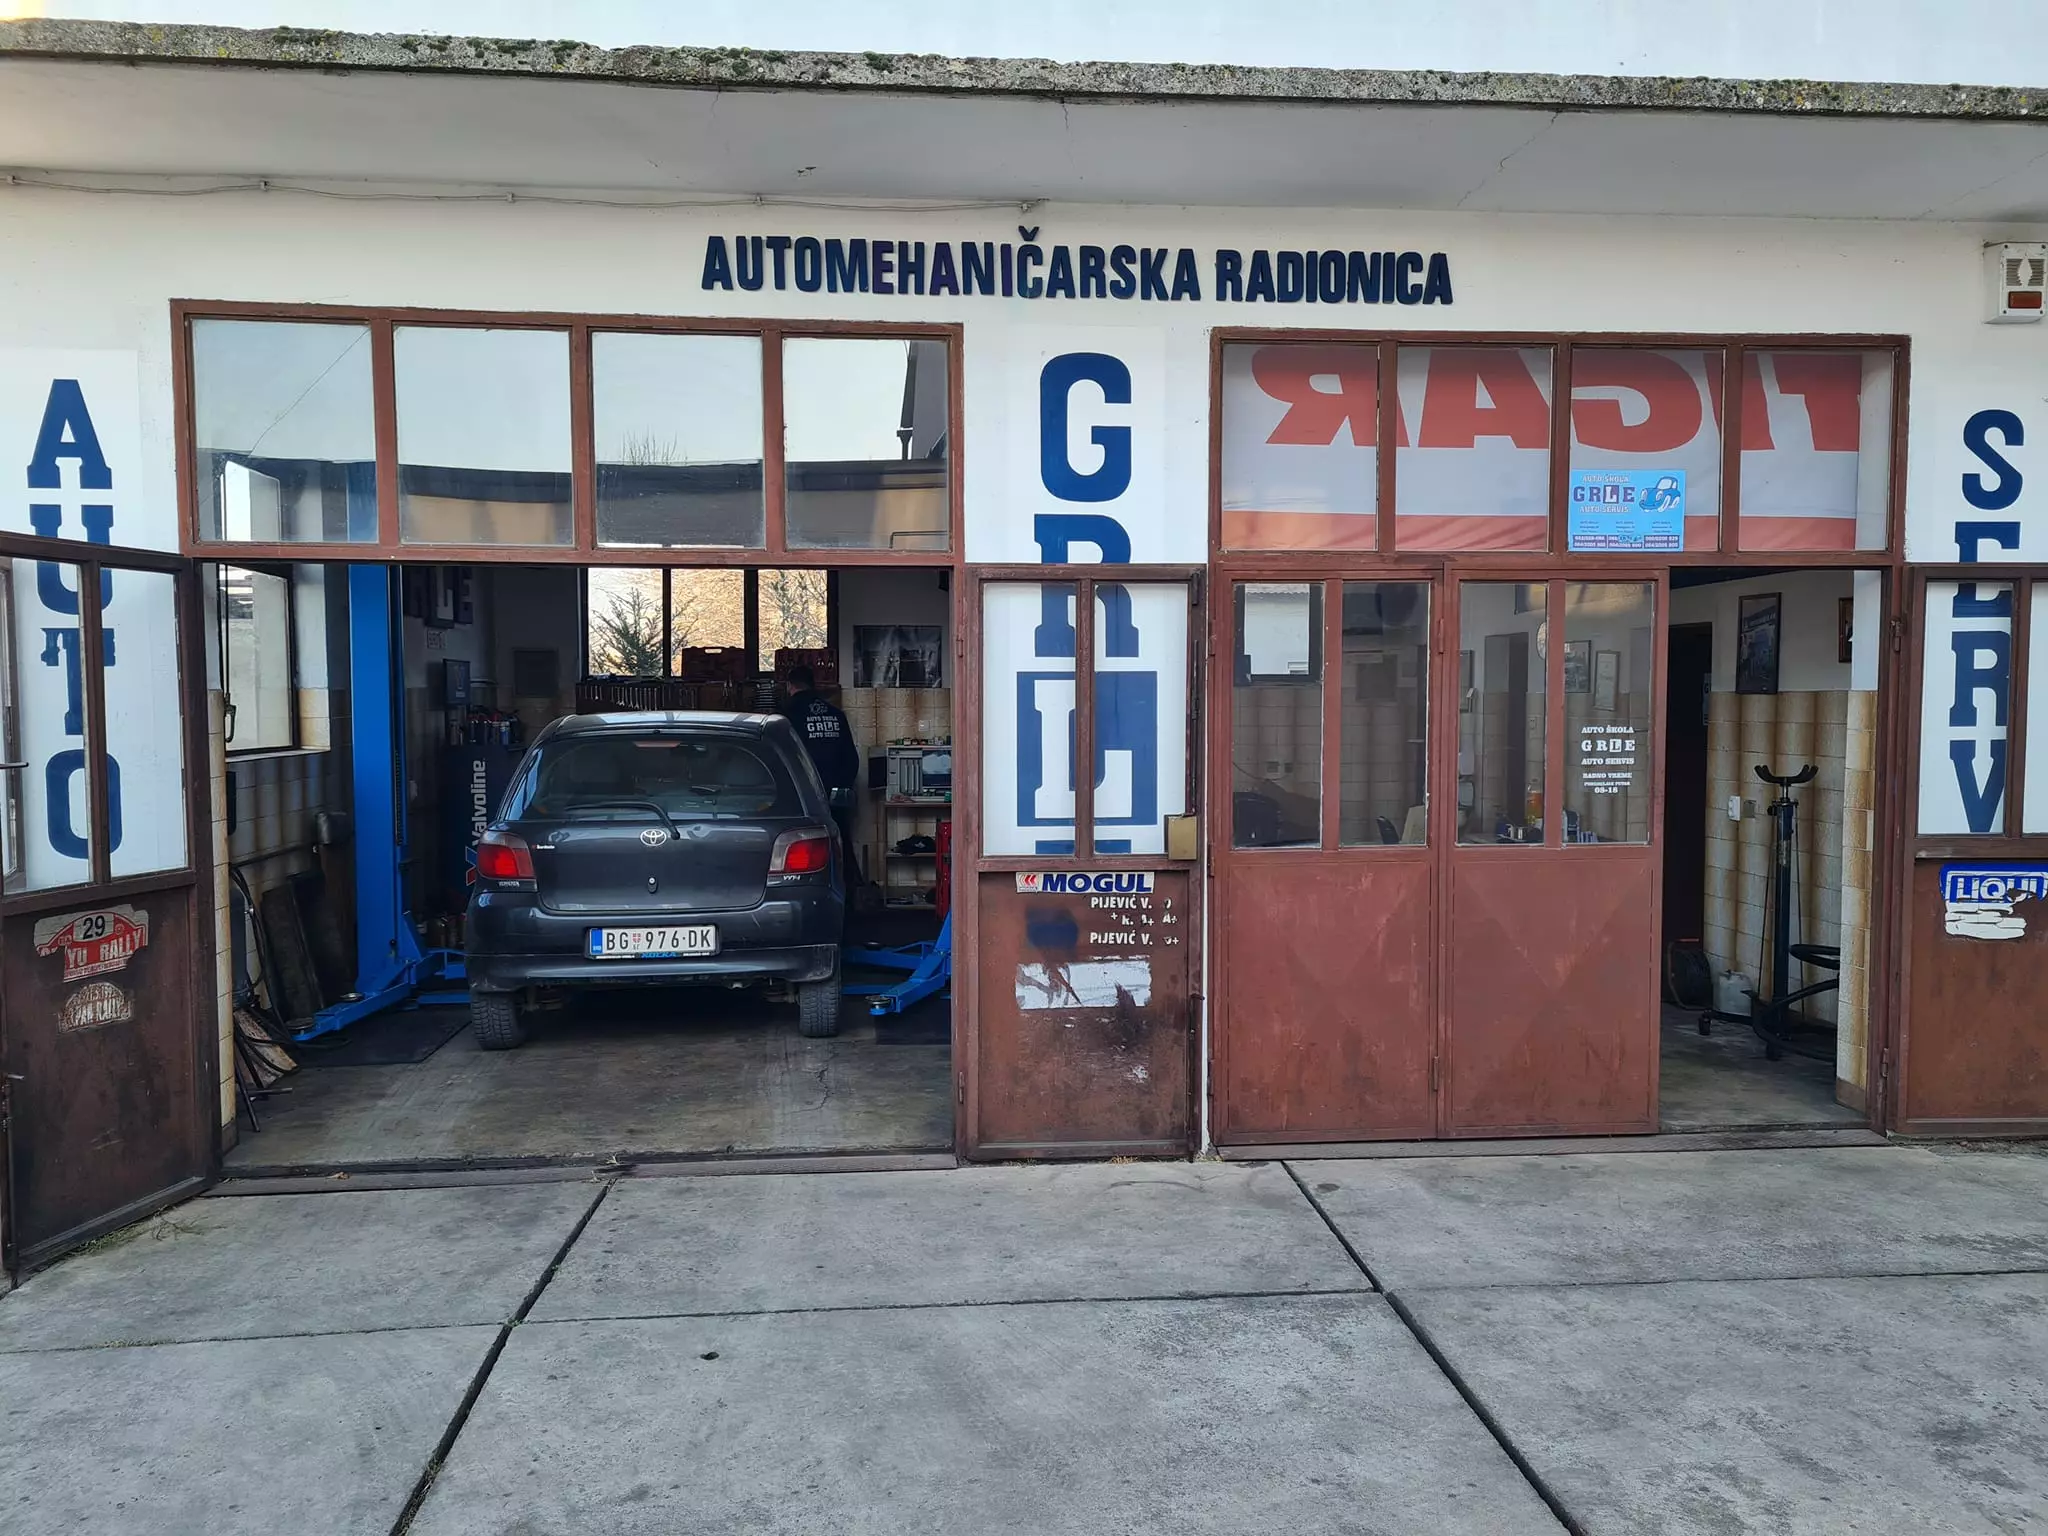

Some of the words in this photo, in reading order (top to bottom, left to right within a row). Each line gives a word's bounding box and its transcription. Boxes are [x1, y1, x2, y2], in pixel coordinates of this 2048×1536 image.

[701, 225, 1201, 302] AUTOMEHANIČARSKA
[1215, 248, 1453, 305] RADIONICA
[1573, 484, 1636, 504] GRLE
[807, 722, 840, 731] GRLE
[1581, 726, 1604, 734] AUTO
[1606, 725, 1634, 734] ŠKOLA
[1581, 739, 1636, 753] GRLE
[471, 760, 489, 847] Valvoline
[1042, 873, 1152, 892] MOGUL
[1091, 894, 1137, 909] PIJEVIĆ
[1140, 897, 1152, 909] V.
[82, 915, 106, 940] 29
[606, 932, 629, 951] BG
[1090, 930, 1136, 944] PIJEVIĆ
[1141, 933, 1153, 945] V.
[67, 948, 88, 968] YU
[99, 929, 142, 962] RALLY
